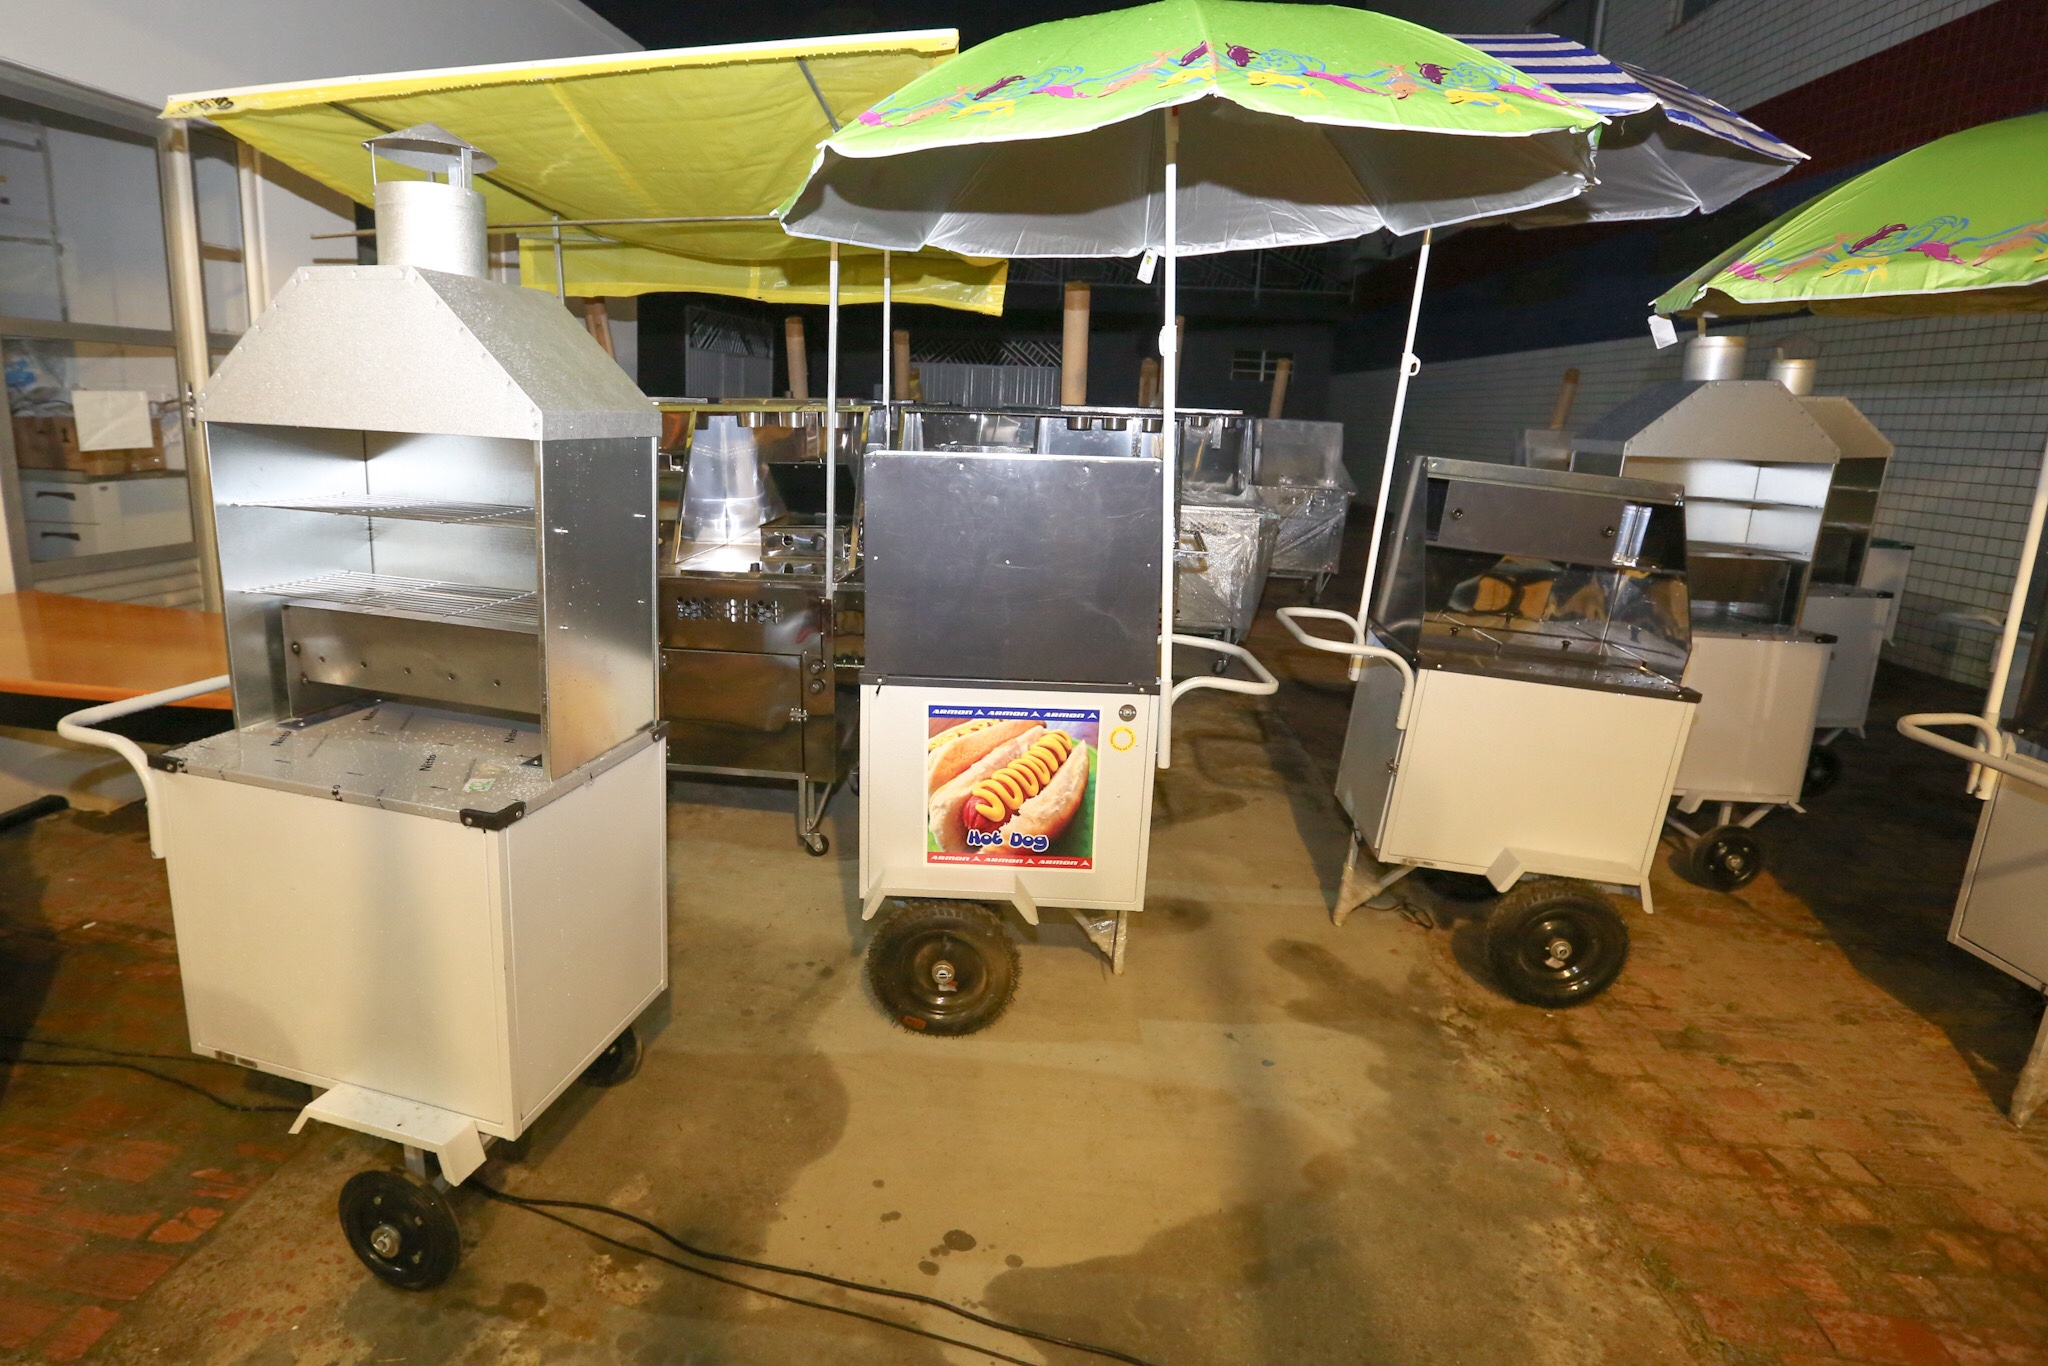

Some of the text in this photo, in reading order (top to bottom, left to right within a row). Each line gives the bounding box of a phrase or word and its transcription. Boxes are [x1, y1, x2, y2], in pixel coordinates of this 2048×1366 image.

[419, 754, 437, 771] Nitto
[968, 830, 1048, 851] Hot Dog
